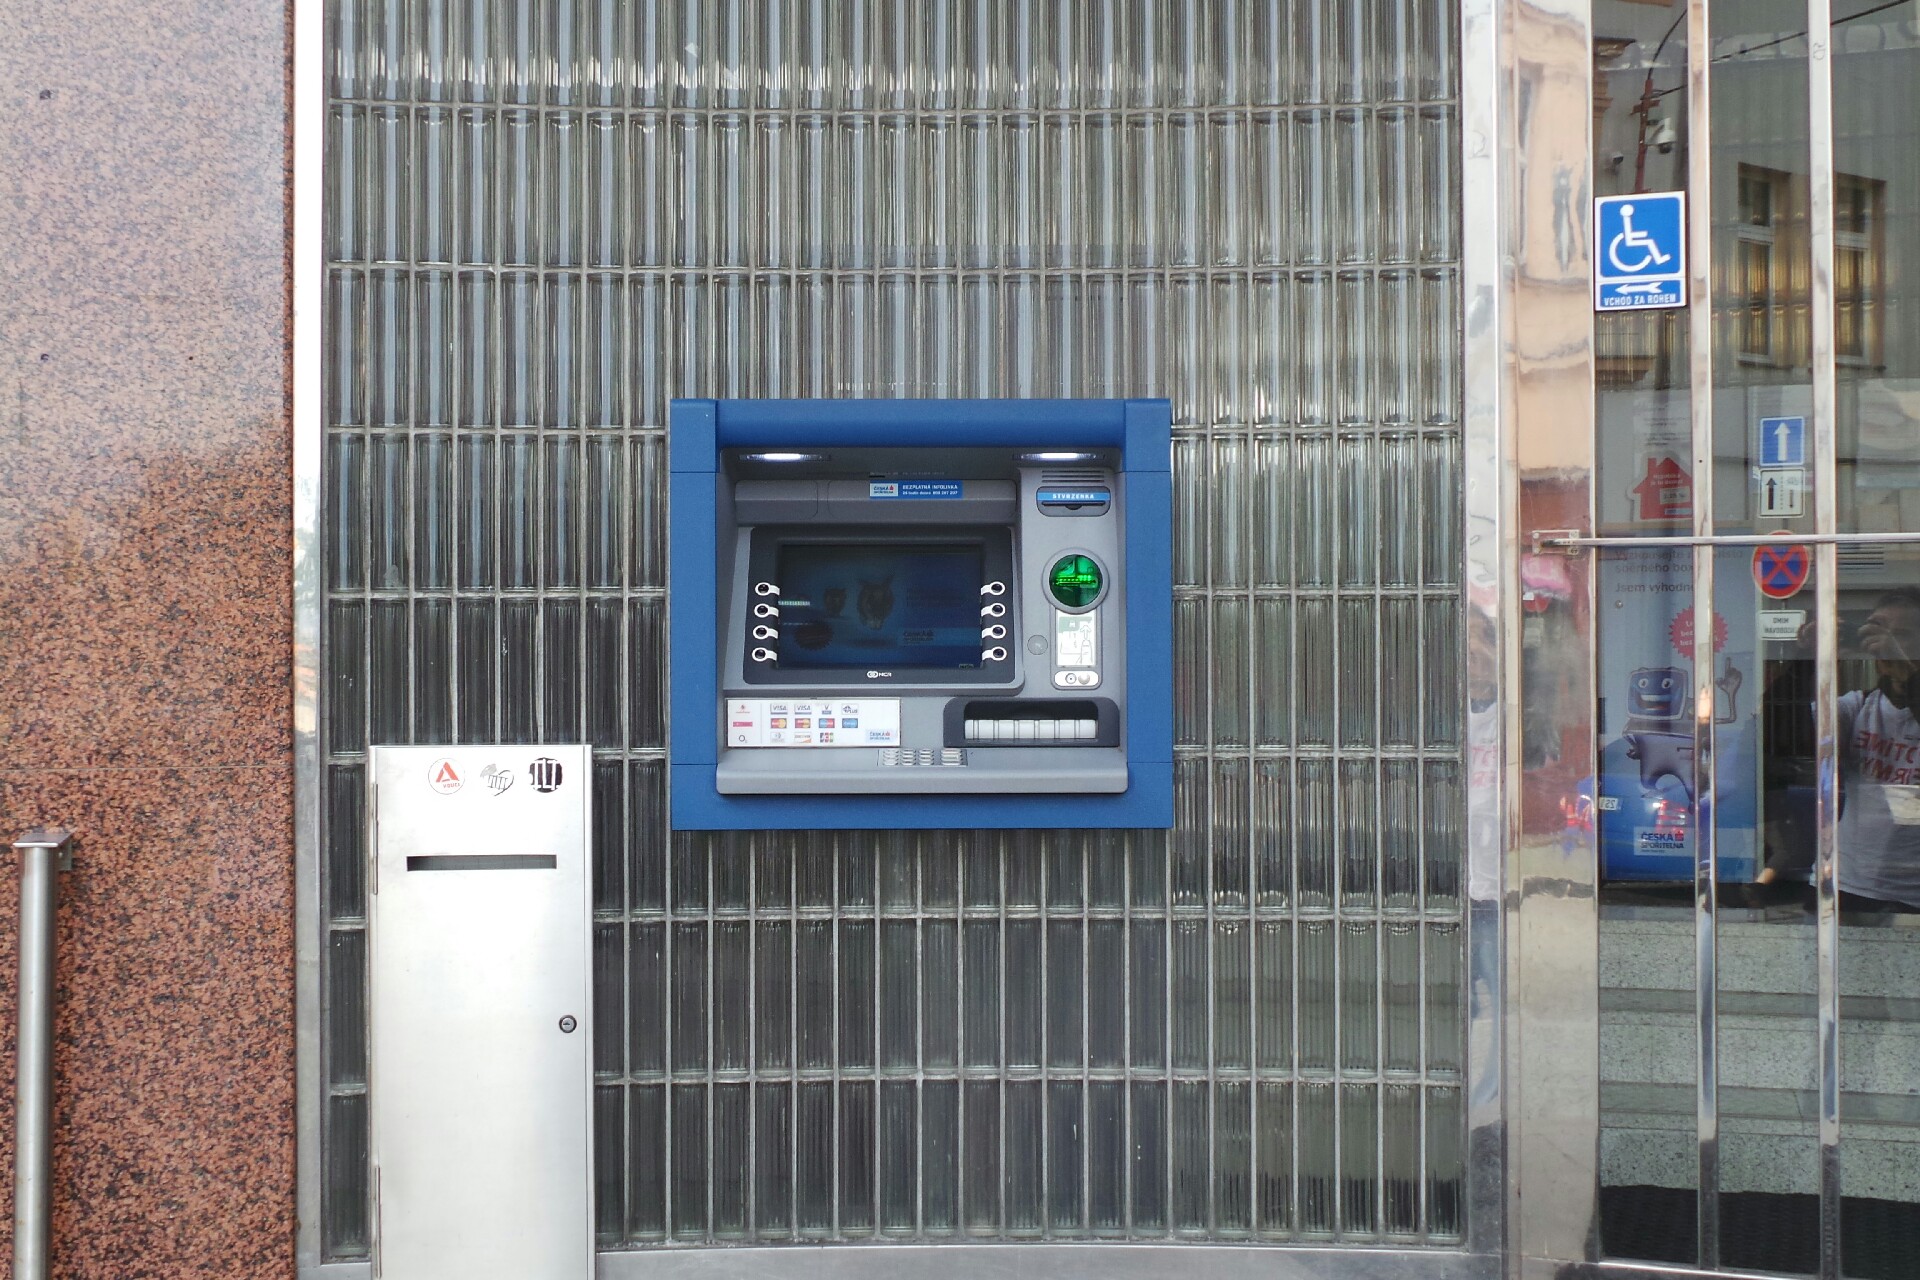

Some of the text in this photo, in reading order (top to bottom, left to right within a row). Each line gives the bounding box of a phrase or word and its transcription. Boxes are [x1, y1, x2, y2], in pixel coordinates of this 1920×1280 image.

[1604, 294, 1676, 306] VCHOD ZA ROHEM
[1615, 583, 1646, 592] Jsem
[1640, 831, 1674, 841] ČESKÁ
[1640, 841, 1684, 849] SPOŘITELNA
